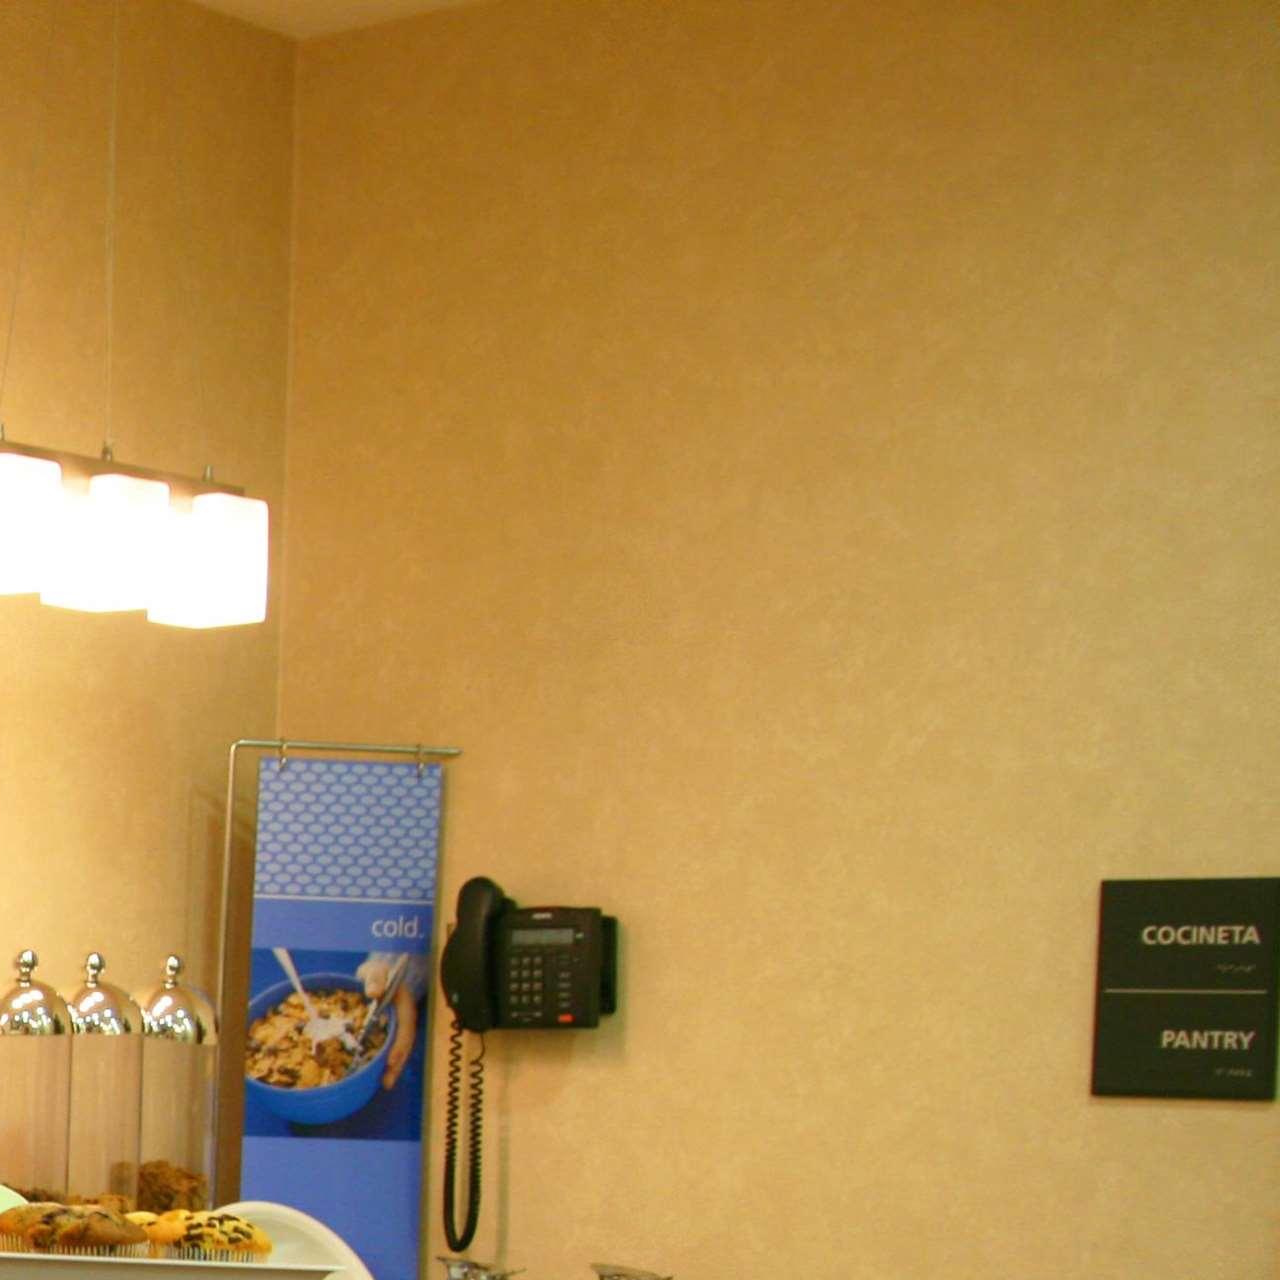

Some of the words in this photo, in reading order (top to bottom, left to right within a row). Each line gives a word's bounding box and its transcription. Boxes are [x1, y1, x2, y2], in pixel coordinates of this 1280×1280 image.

[371, 914, 424, 938] cold.
[1142, 925, 1260, 945] COCINETA
[1161, 1030, 1256, 1050] PANTRY
